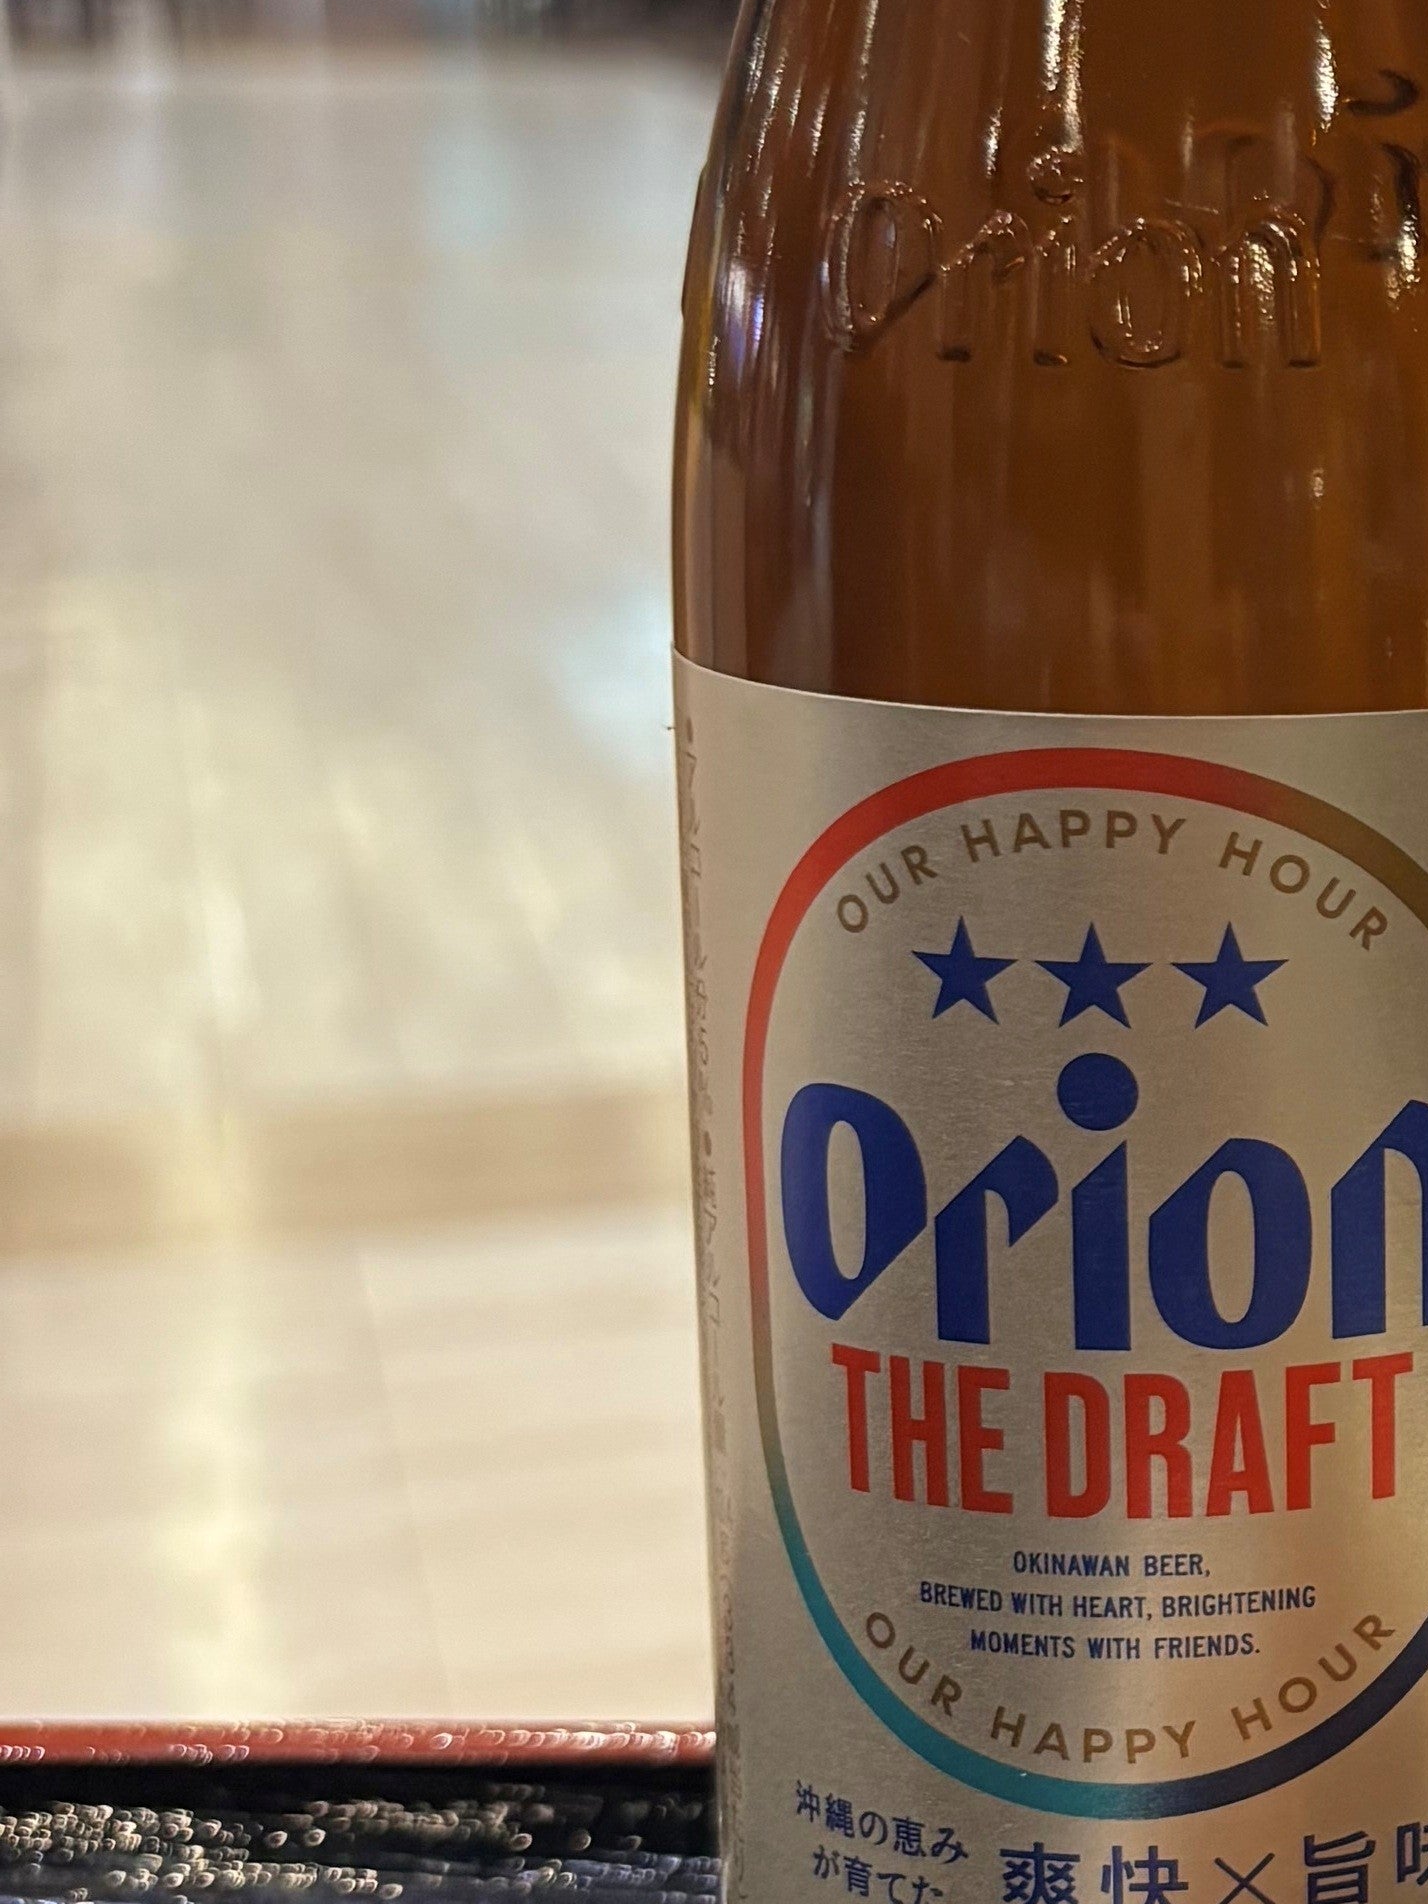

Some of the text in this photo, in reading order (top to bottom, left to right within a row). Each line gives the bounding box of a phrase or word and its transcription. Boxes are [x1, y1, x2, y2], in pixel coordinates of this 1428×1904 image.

[837, 809, 1388, 951] OUR HAPPY HOUR
[830, 1342, 1414, 1520] THE DRAFT
[920, 1581, 1317, 1622] BREWED WITH HEART, BRIGHTENING
[1013, 1550, 1212, 1579] OKINAWAN BEER,
[970, 1628, 1262, 1660] MOMENTS WITH FRIENDS.
[866, 1611, 1396, 1764] OUR HAPPY HOUR
[795, 1780, 970, 1866] 沖縄の恵み
